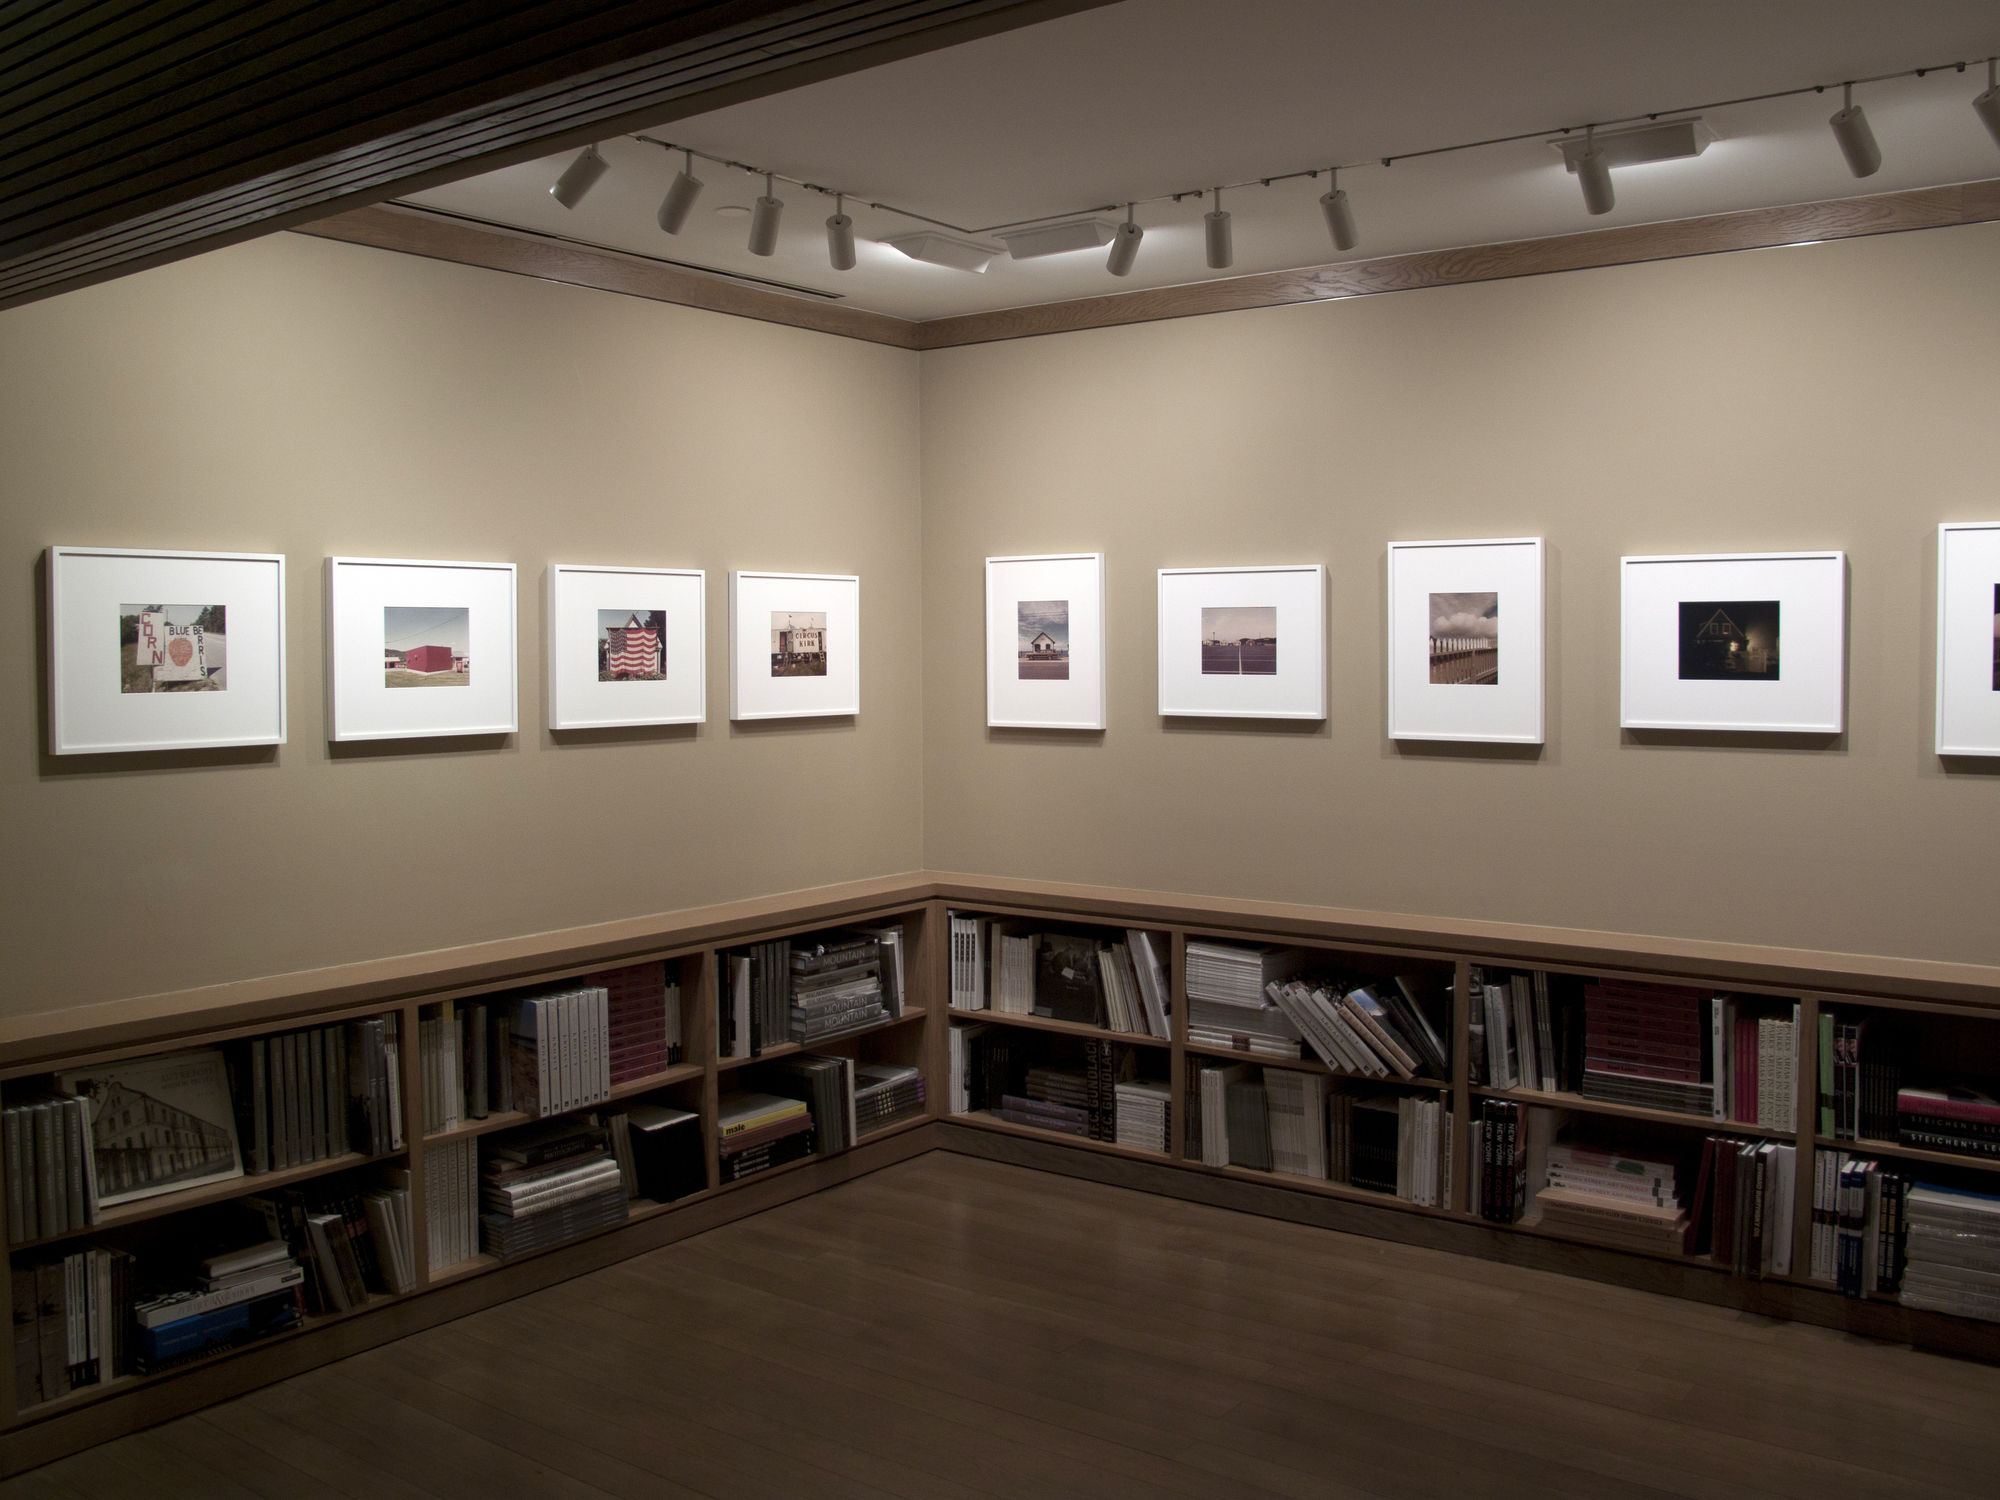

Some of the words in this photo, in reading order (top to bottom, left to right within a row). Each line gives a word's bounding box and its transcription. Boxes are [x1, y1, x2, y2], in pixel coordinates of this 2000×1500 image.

[141, 612, 163, 664] CORN
[169, 626, 190, 636] BLUE
[795, 632, 818, 640] CIRCUS
[799, 640, 815, 648] KIRK
[823, 949, 865, 966] MOUNTAIN
[824, 997, 867, 1015] MOUNTAIN
[824, 1009, 868, 1028] MOUNTAIN
[1485, 1120, 1493, 1139] NEW
[1507, 1122, 1515, 1143] NEW
[1485, 1141, 1493, 1163] YORK
[1911, 1133, 1978, 1150] STEICHEN'S
[1984, 1144, 2000, 1152] LE
[1495, 1144, 1503, 1166] YORK
[1506, 1144, 1514, 1166] YORK
[1484, 1175, 1492, 1206] COLOR
[1505, 1178, 1513, 1207] COLOR
